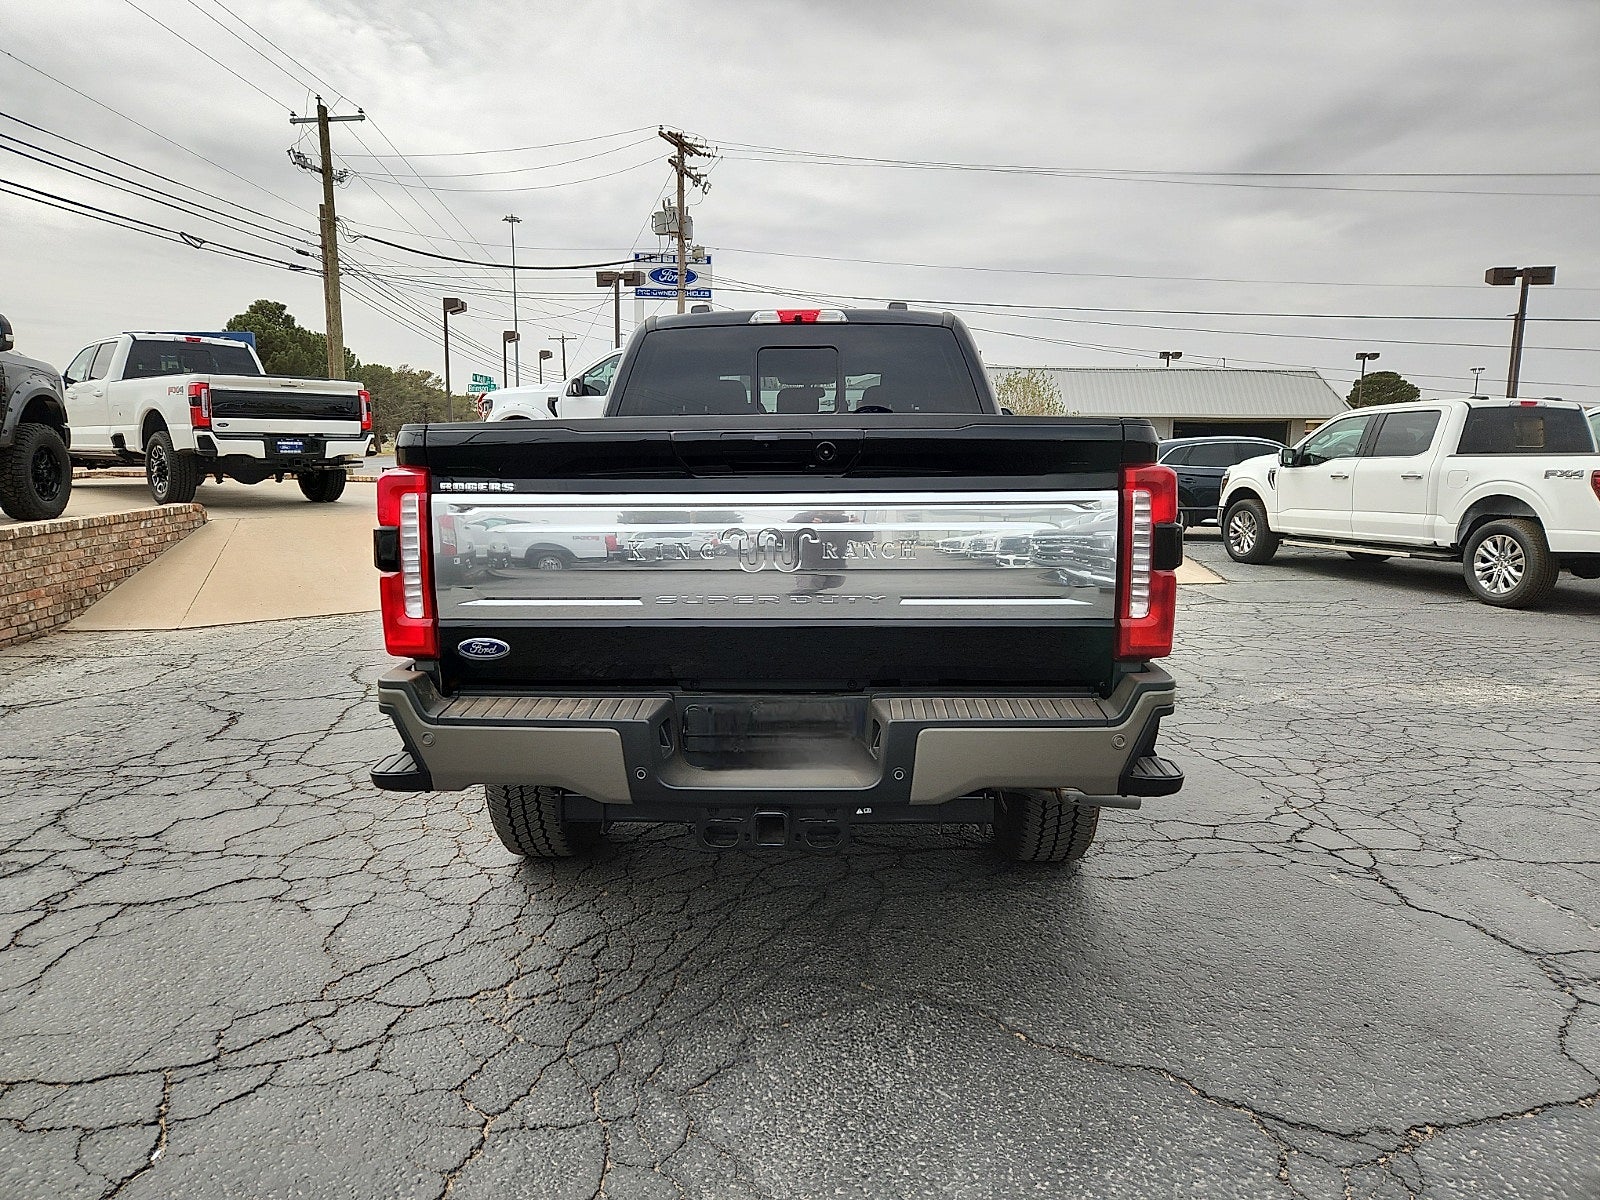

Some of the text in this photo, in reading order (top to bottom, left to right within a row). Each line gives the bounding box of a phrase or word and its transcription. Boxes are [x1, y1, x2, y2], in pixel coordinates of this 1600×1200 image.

[659, 269, 687, 282] For
[168, 386, 184, 395] FX4
[1544, 469, 1585, 479] FX4
[439, 482, 515, 492] ROGERS
[627, 539, 918, 561] KING RANCH
[655, 594, 887, 605] SUPER DUTY
[470, 641, 498, 654] Ford
